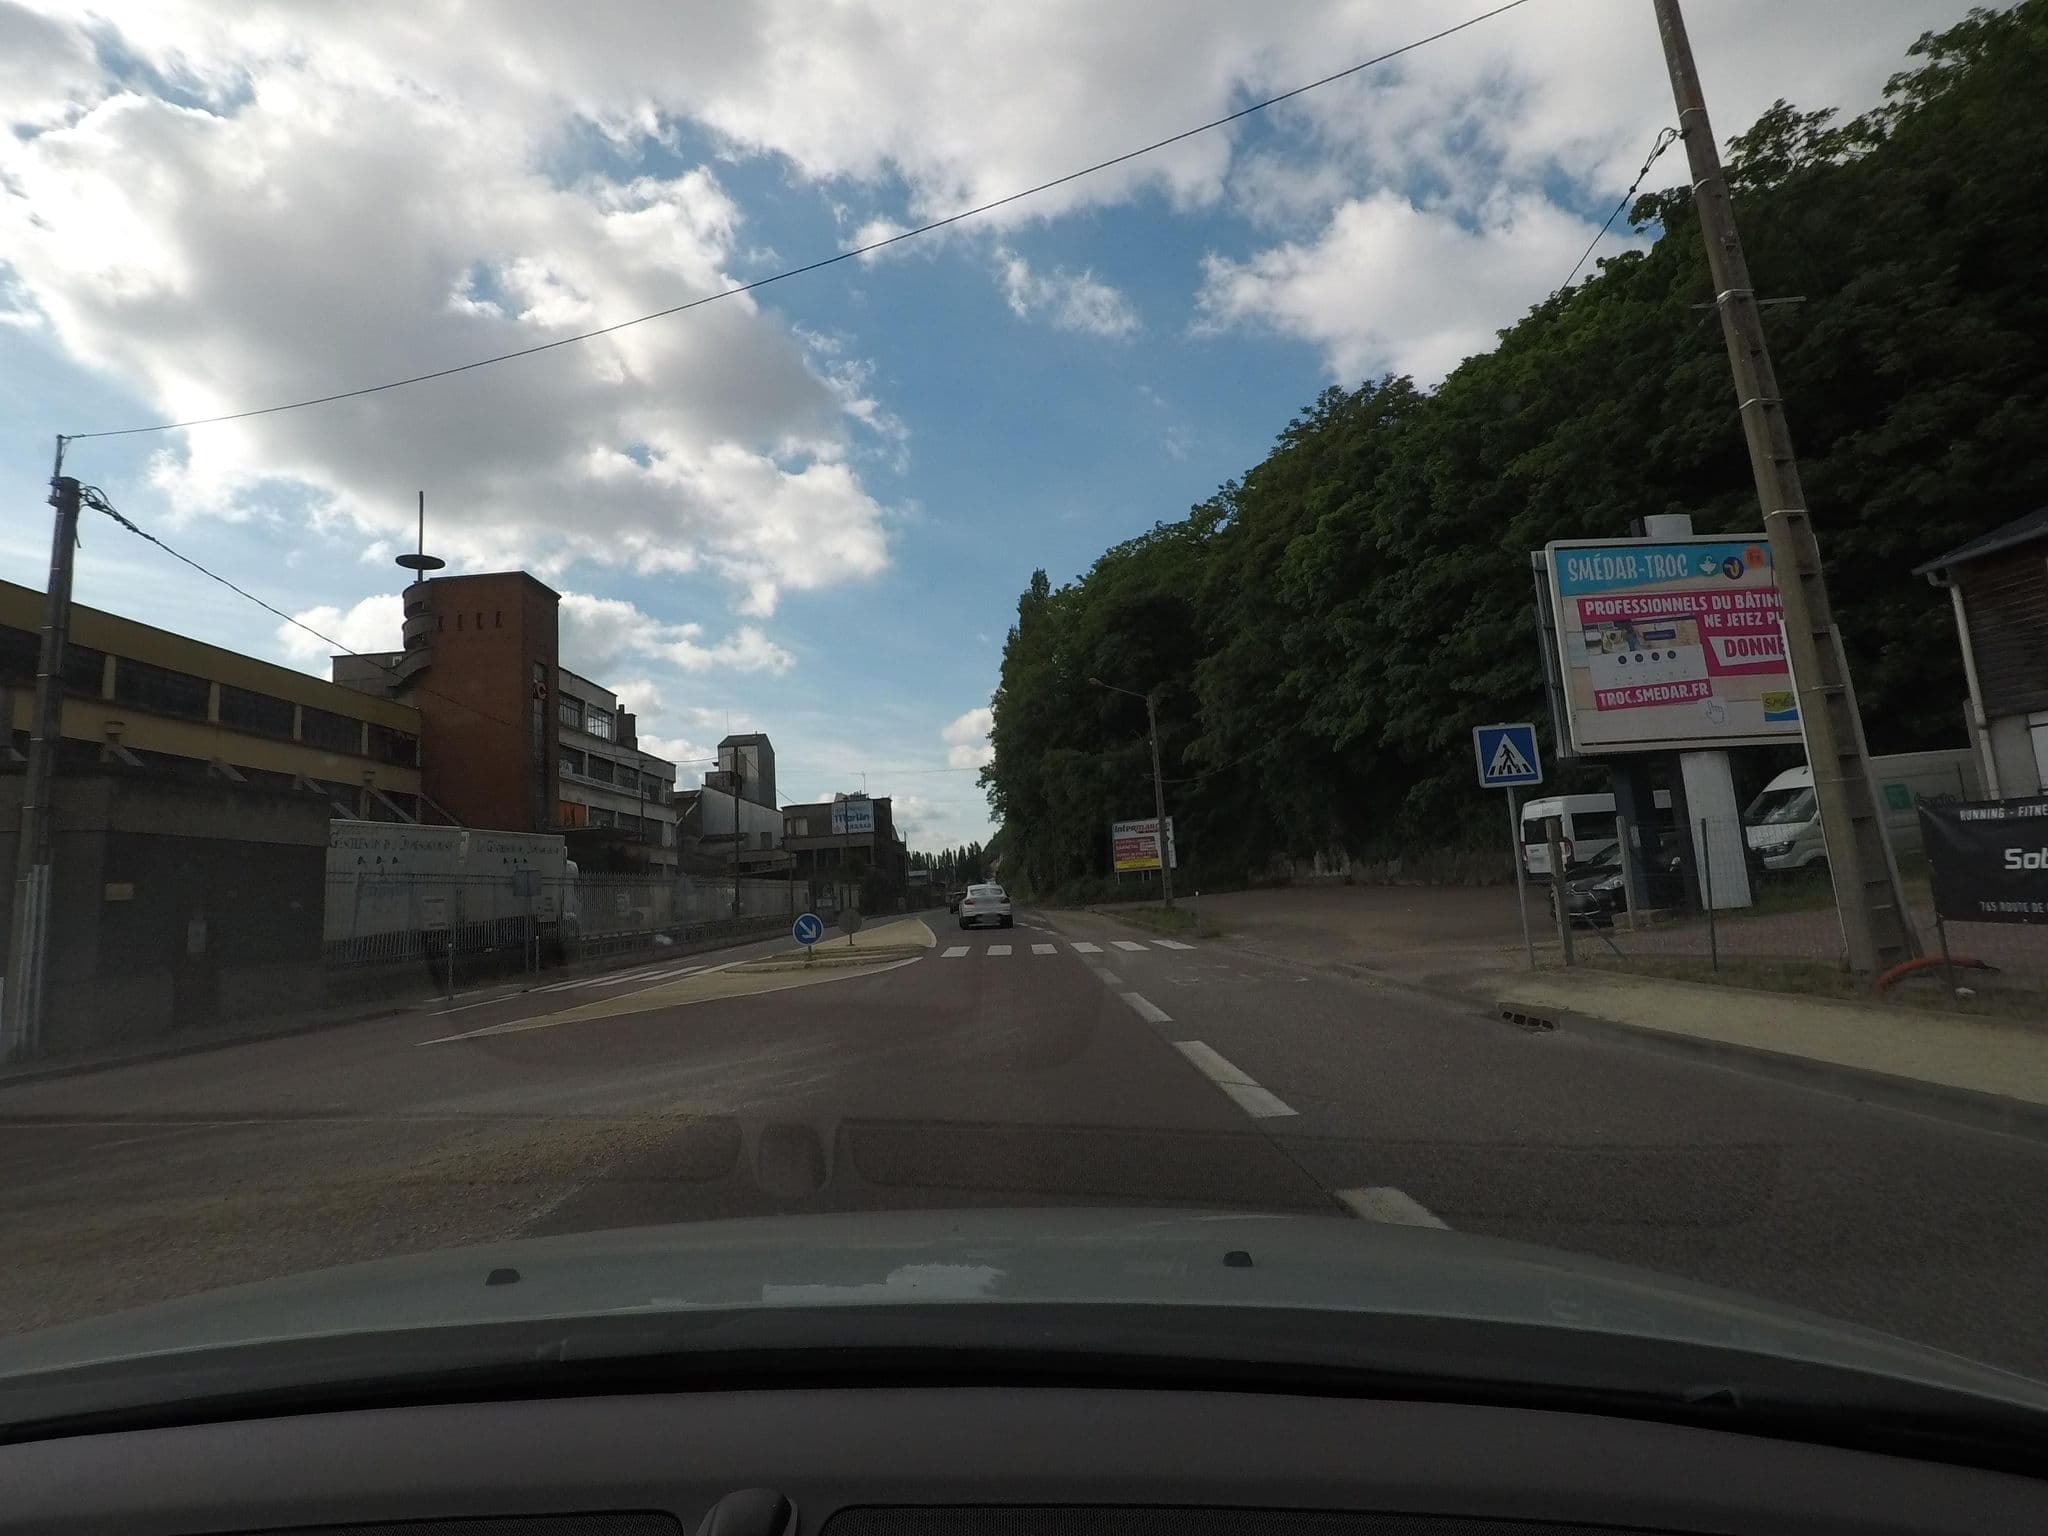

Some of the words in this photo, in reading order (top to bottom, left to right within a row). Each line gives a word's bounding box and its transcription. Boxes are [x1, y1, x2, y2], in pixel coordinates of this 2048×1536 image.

[1567, 552, 1689, 582] SMÉDAR-TROC
[1585, 596, 1708, 616] PROFESSIONNELS
[1711, 594, 1732, 610] DU
[1704, 613, 1722, 628] NE
[1726, 611, 1763, 627] JETEZ
[1599, 682, 1709, 706] TROC.SMEDAR.FR
